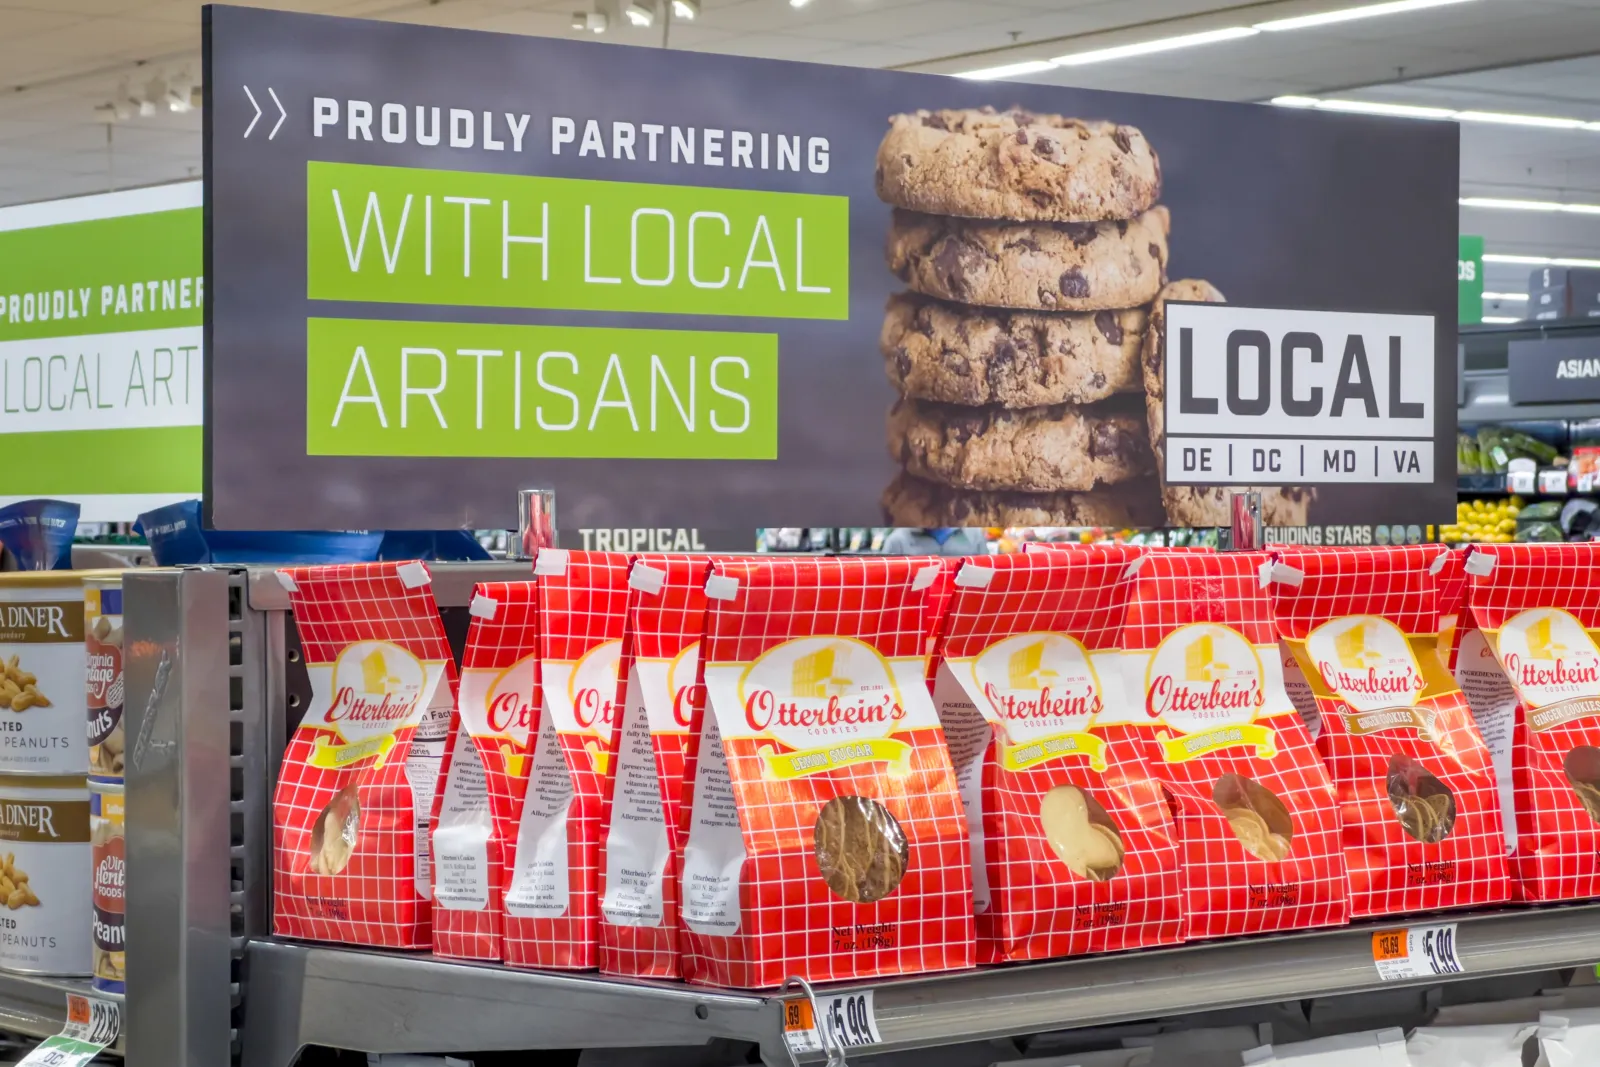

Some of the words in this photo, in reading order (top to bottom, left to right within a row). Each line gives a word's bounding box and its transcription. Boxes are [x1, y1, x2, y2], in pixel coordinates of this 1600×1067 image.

[313, 97, 530, 152] PROUDLY
[552, 116, 830, 174] PARTNERING
[332, 189, 548, 281] WITH
[584, 205, 831, 293] LOCAL
[5, 352, 113, 413] LOCAL
[125, 346, 198, 407] ART
[1180, 327, 1424, 418] LOCAL
[332, 346, 750, 433] ARTISANS
[1183, 448, 1212, 471] DE
[1253, 449, 1281, 472] DC
[1324, 450, 1356, 472] MD
[1394, 451, 1420, 473] VA
[579, 528, 705, 551] TROPICAL
[1264, 527, 1321, 545] GUIDING
[1326, 525, 1371, 545] STARS
[8, 606, 69, 637] DINER
[1319, 660, 1428, 695] Otterbein's
[1544, 685, 1580, 693] COOKIES
[323, 687, 418, 723] Otterbein's
[1145, 675, 1265, 718] Otterbein's
[745, 690, 907, 732] Otterbein's
[1380, 711, 1413, 724] COOKIES
[1532, 705, 1564, 726] GINGER
[808, 725, 858, 735] COOKIES
[1024, 719, 1064, 728] COOKIES
[5, 737, 69, 749] PEANUTS
[789, 752, 828, 771] LEMON
[829, 744, 873, 762] SUGAR
[6, 804, 58, 837] DINER
[1408, 863, 1421, 872] Net
[1425, 861, 1455, 870] Weight:
[1249, 885, 1264, 894] Net
[1266, 883, 1298, 894] Weight:
[1076, 906, 1090, 915] Net
[1093, 901, 1126, 912] Weight:
[3, 933, 56, 948] PEANUTS
[832, 926, 852, 937] Net
[855, 923, 896, 936] Weight:
[834, 940, 840, 950] 7
[844, 940, 859, 950] oz.
[862, 937, 894, 949] (198g)
[1422, 928, 1460, 974] $5.99
